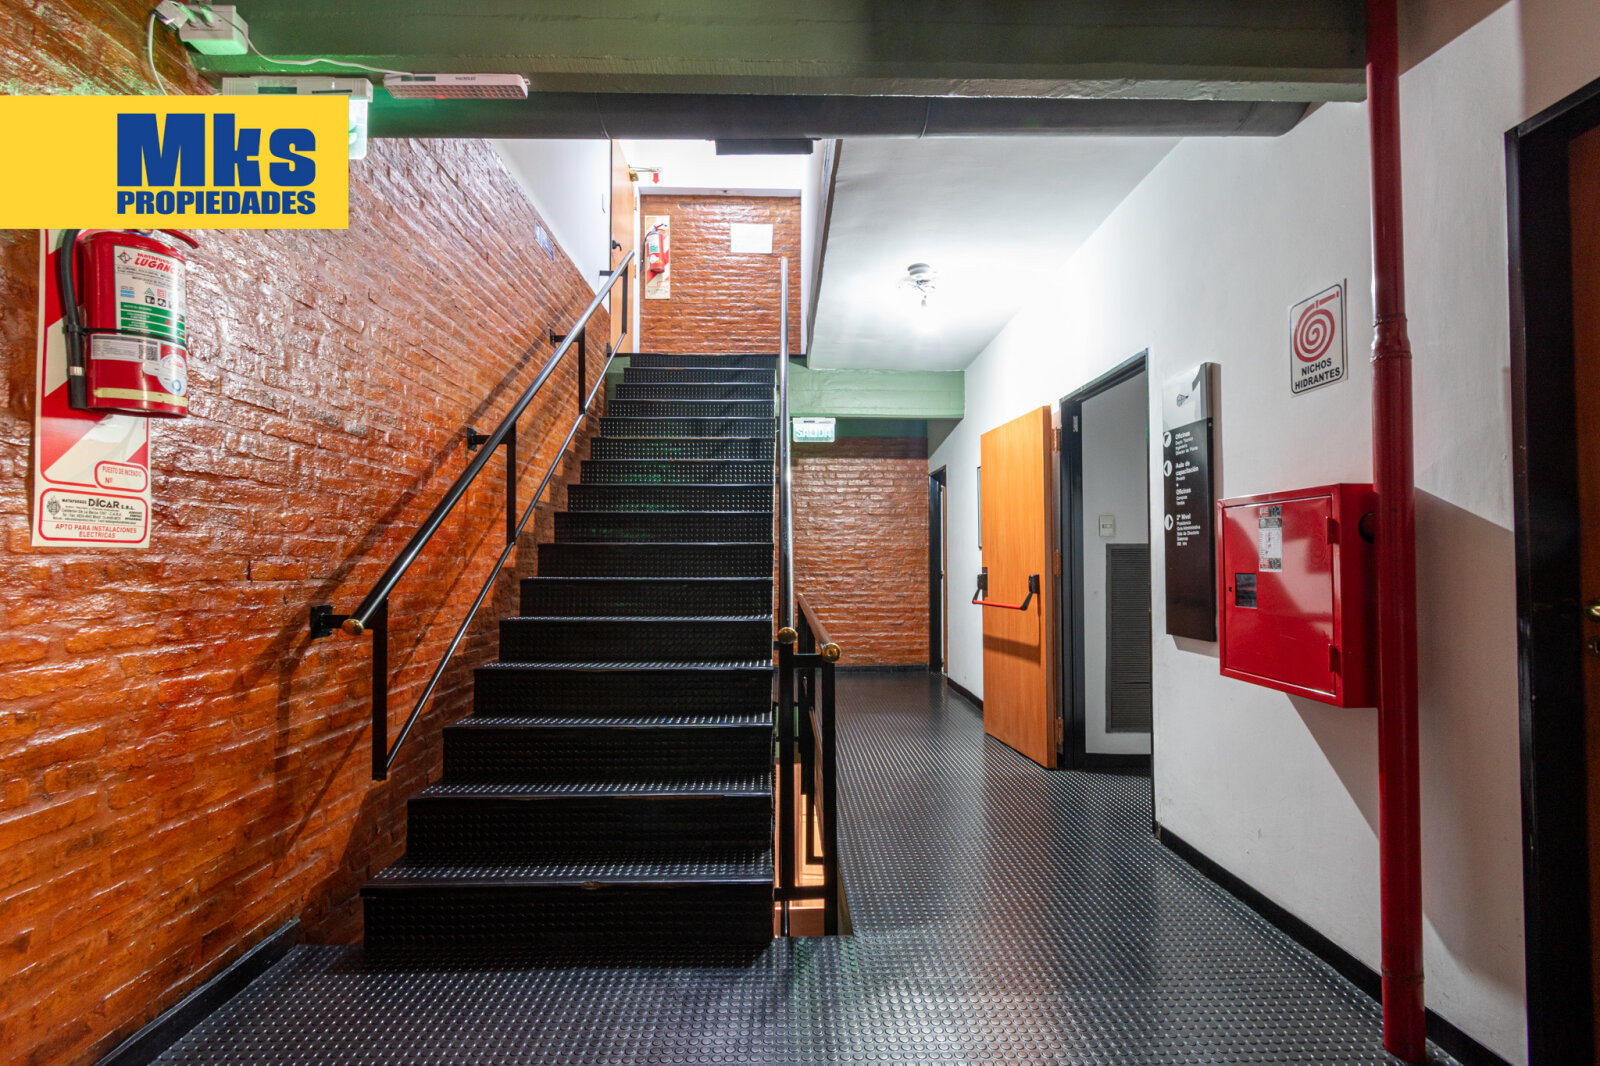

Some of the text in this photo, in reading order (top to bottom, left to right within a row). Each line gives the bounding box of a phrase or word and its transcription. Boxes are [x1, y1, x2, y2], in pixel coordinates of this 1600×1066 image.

[1301, 357, 1332, 376] NICHOS
[1294, 366, 1341, 390] HIDRANTES
[1176, 432, 1191, 440] Oficinas
[103, 466, 118, 474] PUESTO
[1176, 466, 1199, 476] capacitación
[93, 526, 137, 534] INSTALACIONES
